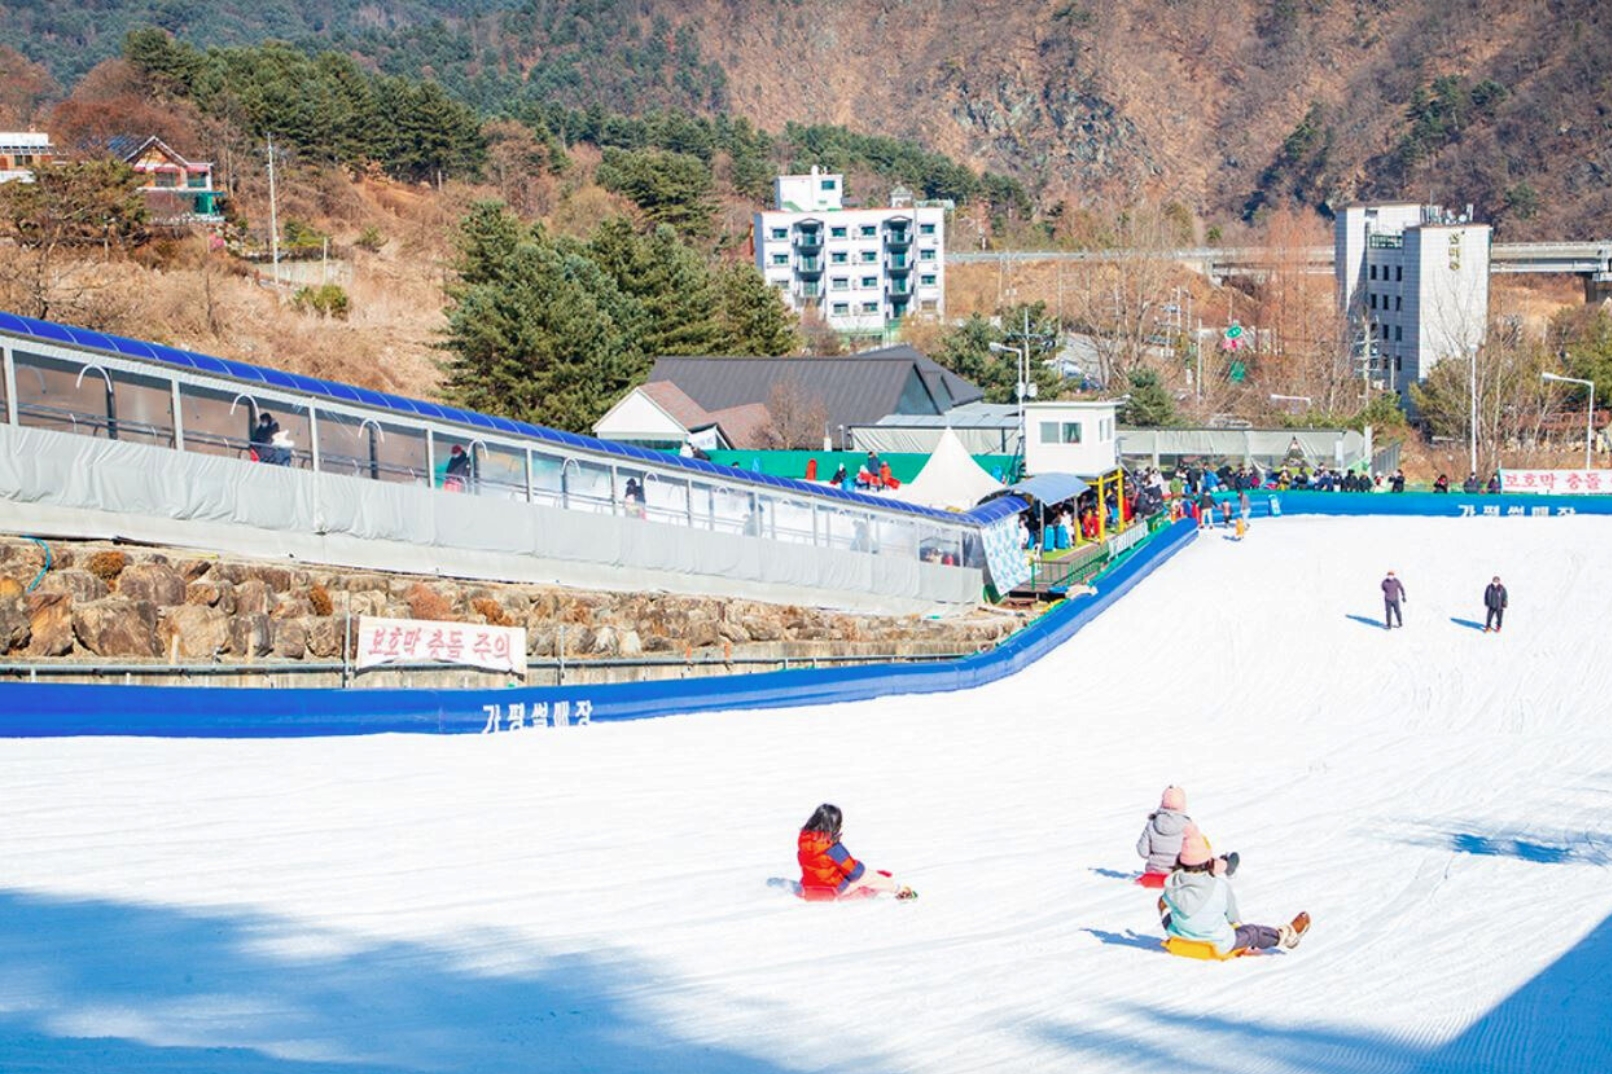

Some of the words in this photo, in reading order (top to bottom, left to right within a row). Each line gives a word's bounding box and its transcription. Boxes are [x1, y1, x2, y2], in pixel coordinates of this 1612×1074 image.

[1504, 473, 1557, 490] 보호막
[1565, 473, 1602, 490] 충돌
[368, 627, 422, 656] 보호막
[426, 630, 465, 659] 충돌
[472, 633, 513, 665] 주의
[481, 699, 593, 734] 가평썰매장
